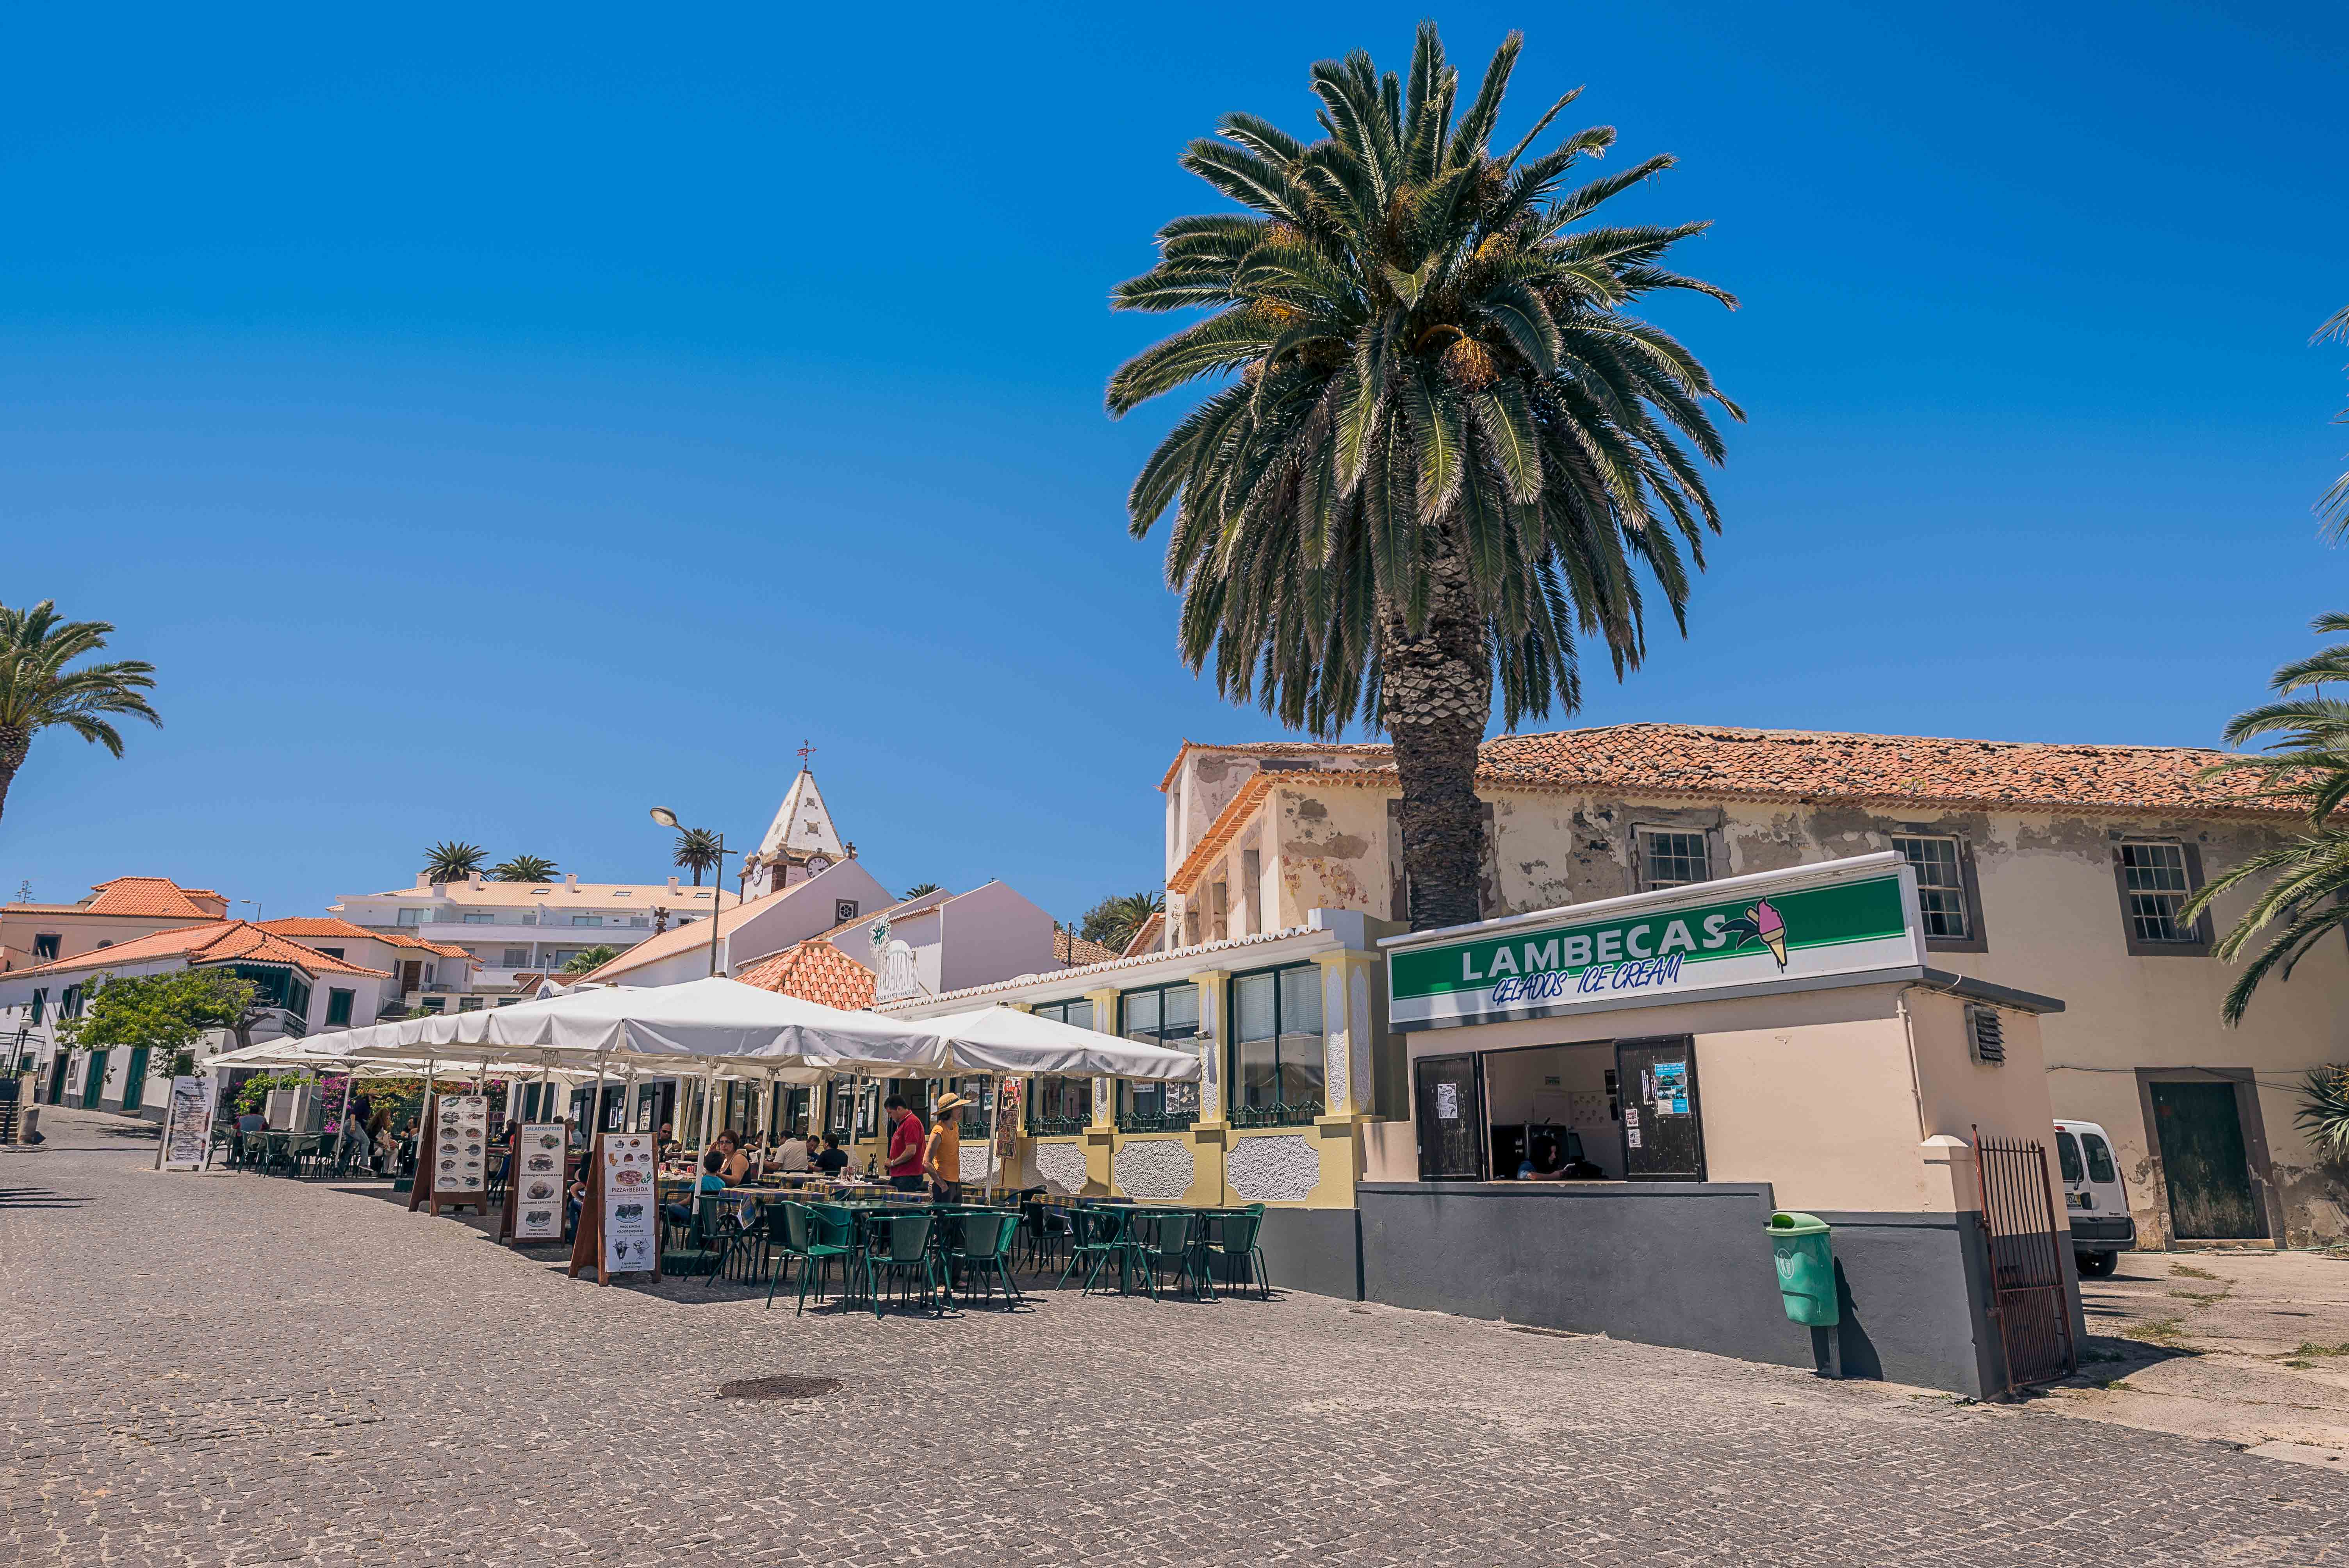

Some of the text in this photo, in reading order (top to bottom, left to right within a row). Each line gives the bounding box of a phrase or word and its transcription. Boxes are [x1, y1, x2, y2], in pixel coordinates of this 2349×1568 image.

[1463, 914, 1727, 980] LAMBECAS
[876, 992, 898, 1001] RESTAURANTE
[1492, 952, 1684, 1005] GELADOS ICE CREAM
